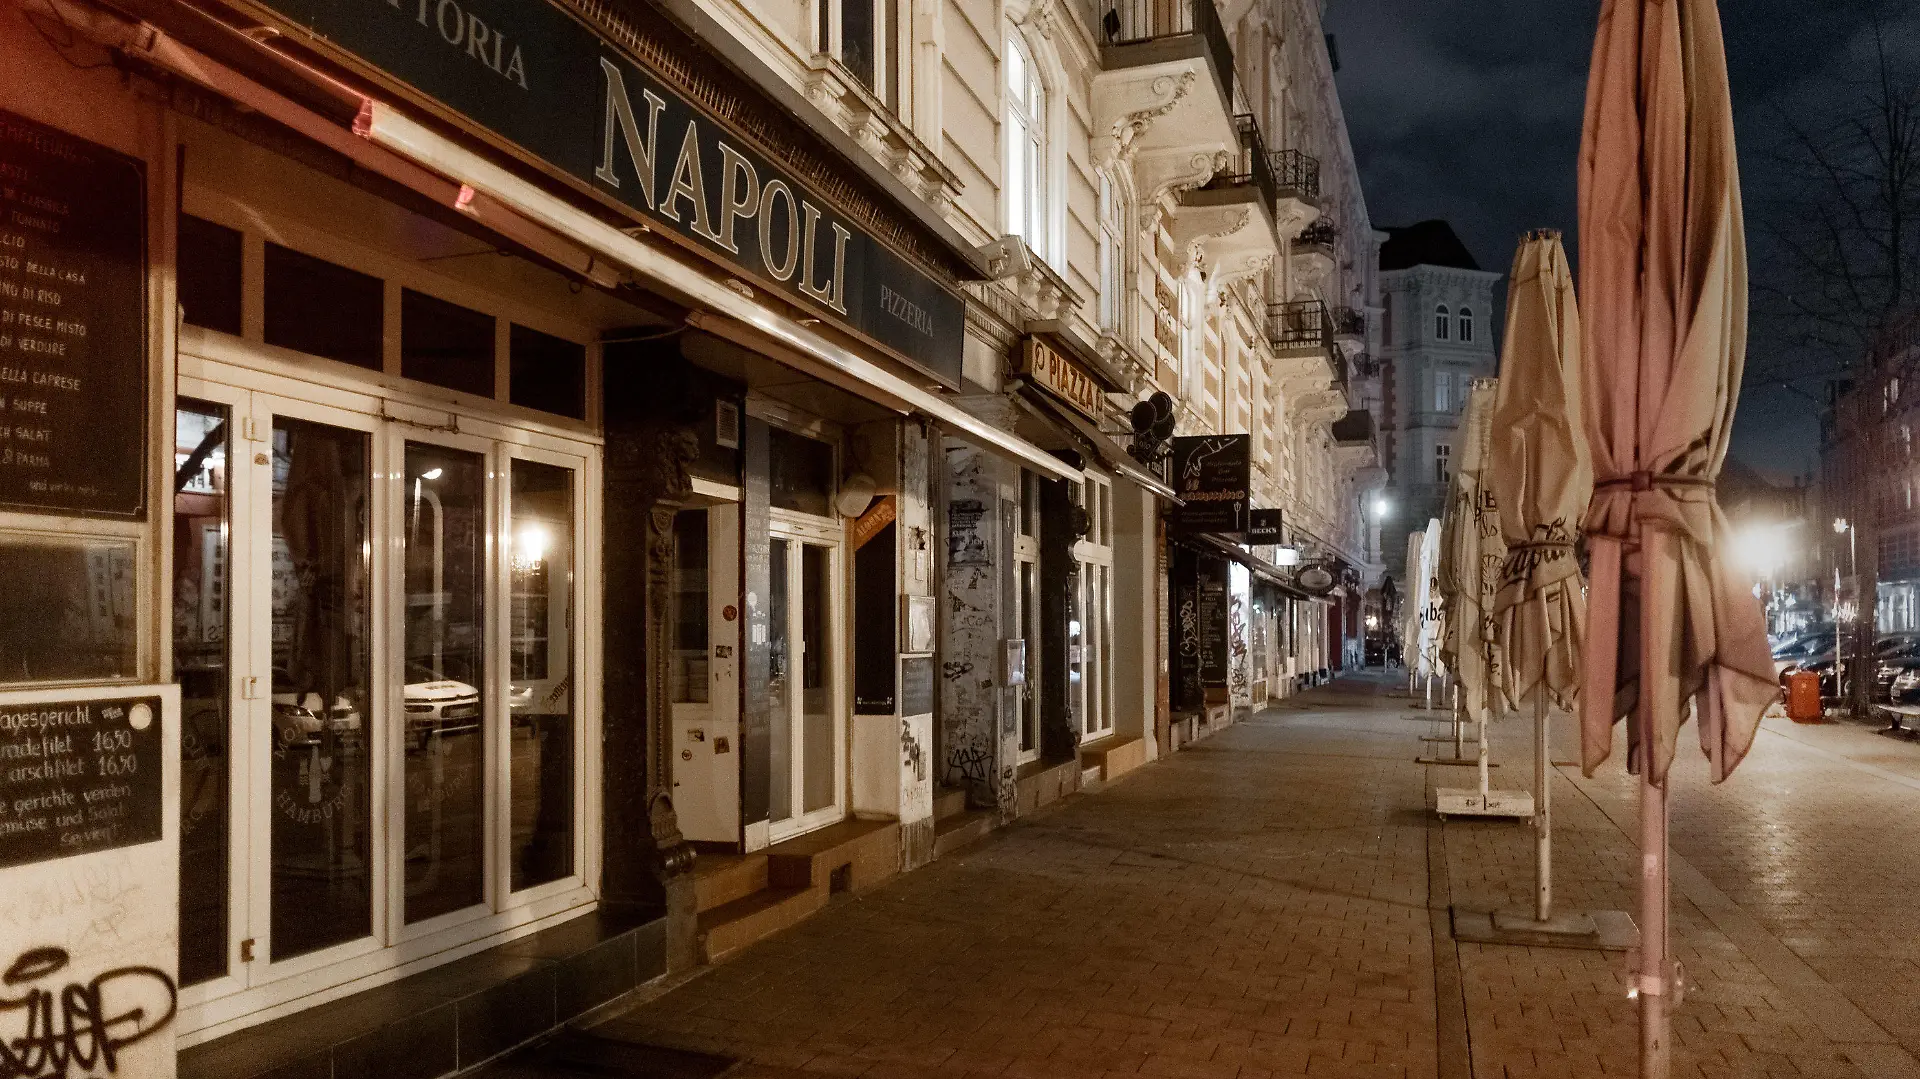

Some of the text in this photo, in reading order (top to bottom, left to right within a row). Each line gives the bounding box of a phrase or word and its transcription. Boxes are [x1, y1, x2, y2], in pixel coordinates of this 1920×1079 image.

[595, 56, 850, 315] NAPOLI
[0, 233, 26, 249] CIO
[58, 270, 87, 285] CASA
[23, 286, 35, 301] DI
[38, 289, 61, 305] RISO
[879, 285, 935, 339] PIZZERIA
[3, 310, 87, 337] DI PESCE MISTO
[19, 338, 67, 356] VERDURE
[33, 371, 82, 391] CAPRESE
[1050, 350, 1094, 414] PIAZZA
[13, 399, 48, 414] SUPPE
[15, 426, 52, 442] SALAT
[16, 451, 50, 468] PARMA
[14, 788, 75, 818] gerichte
[56, 808, 83, 827] und
